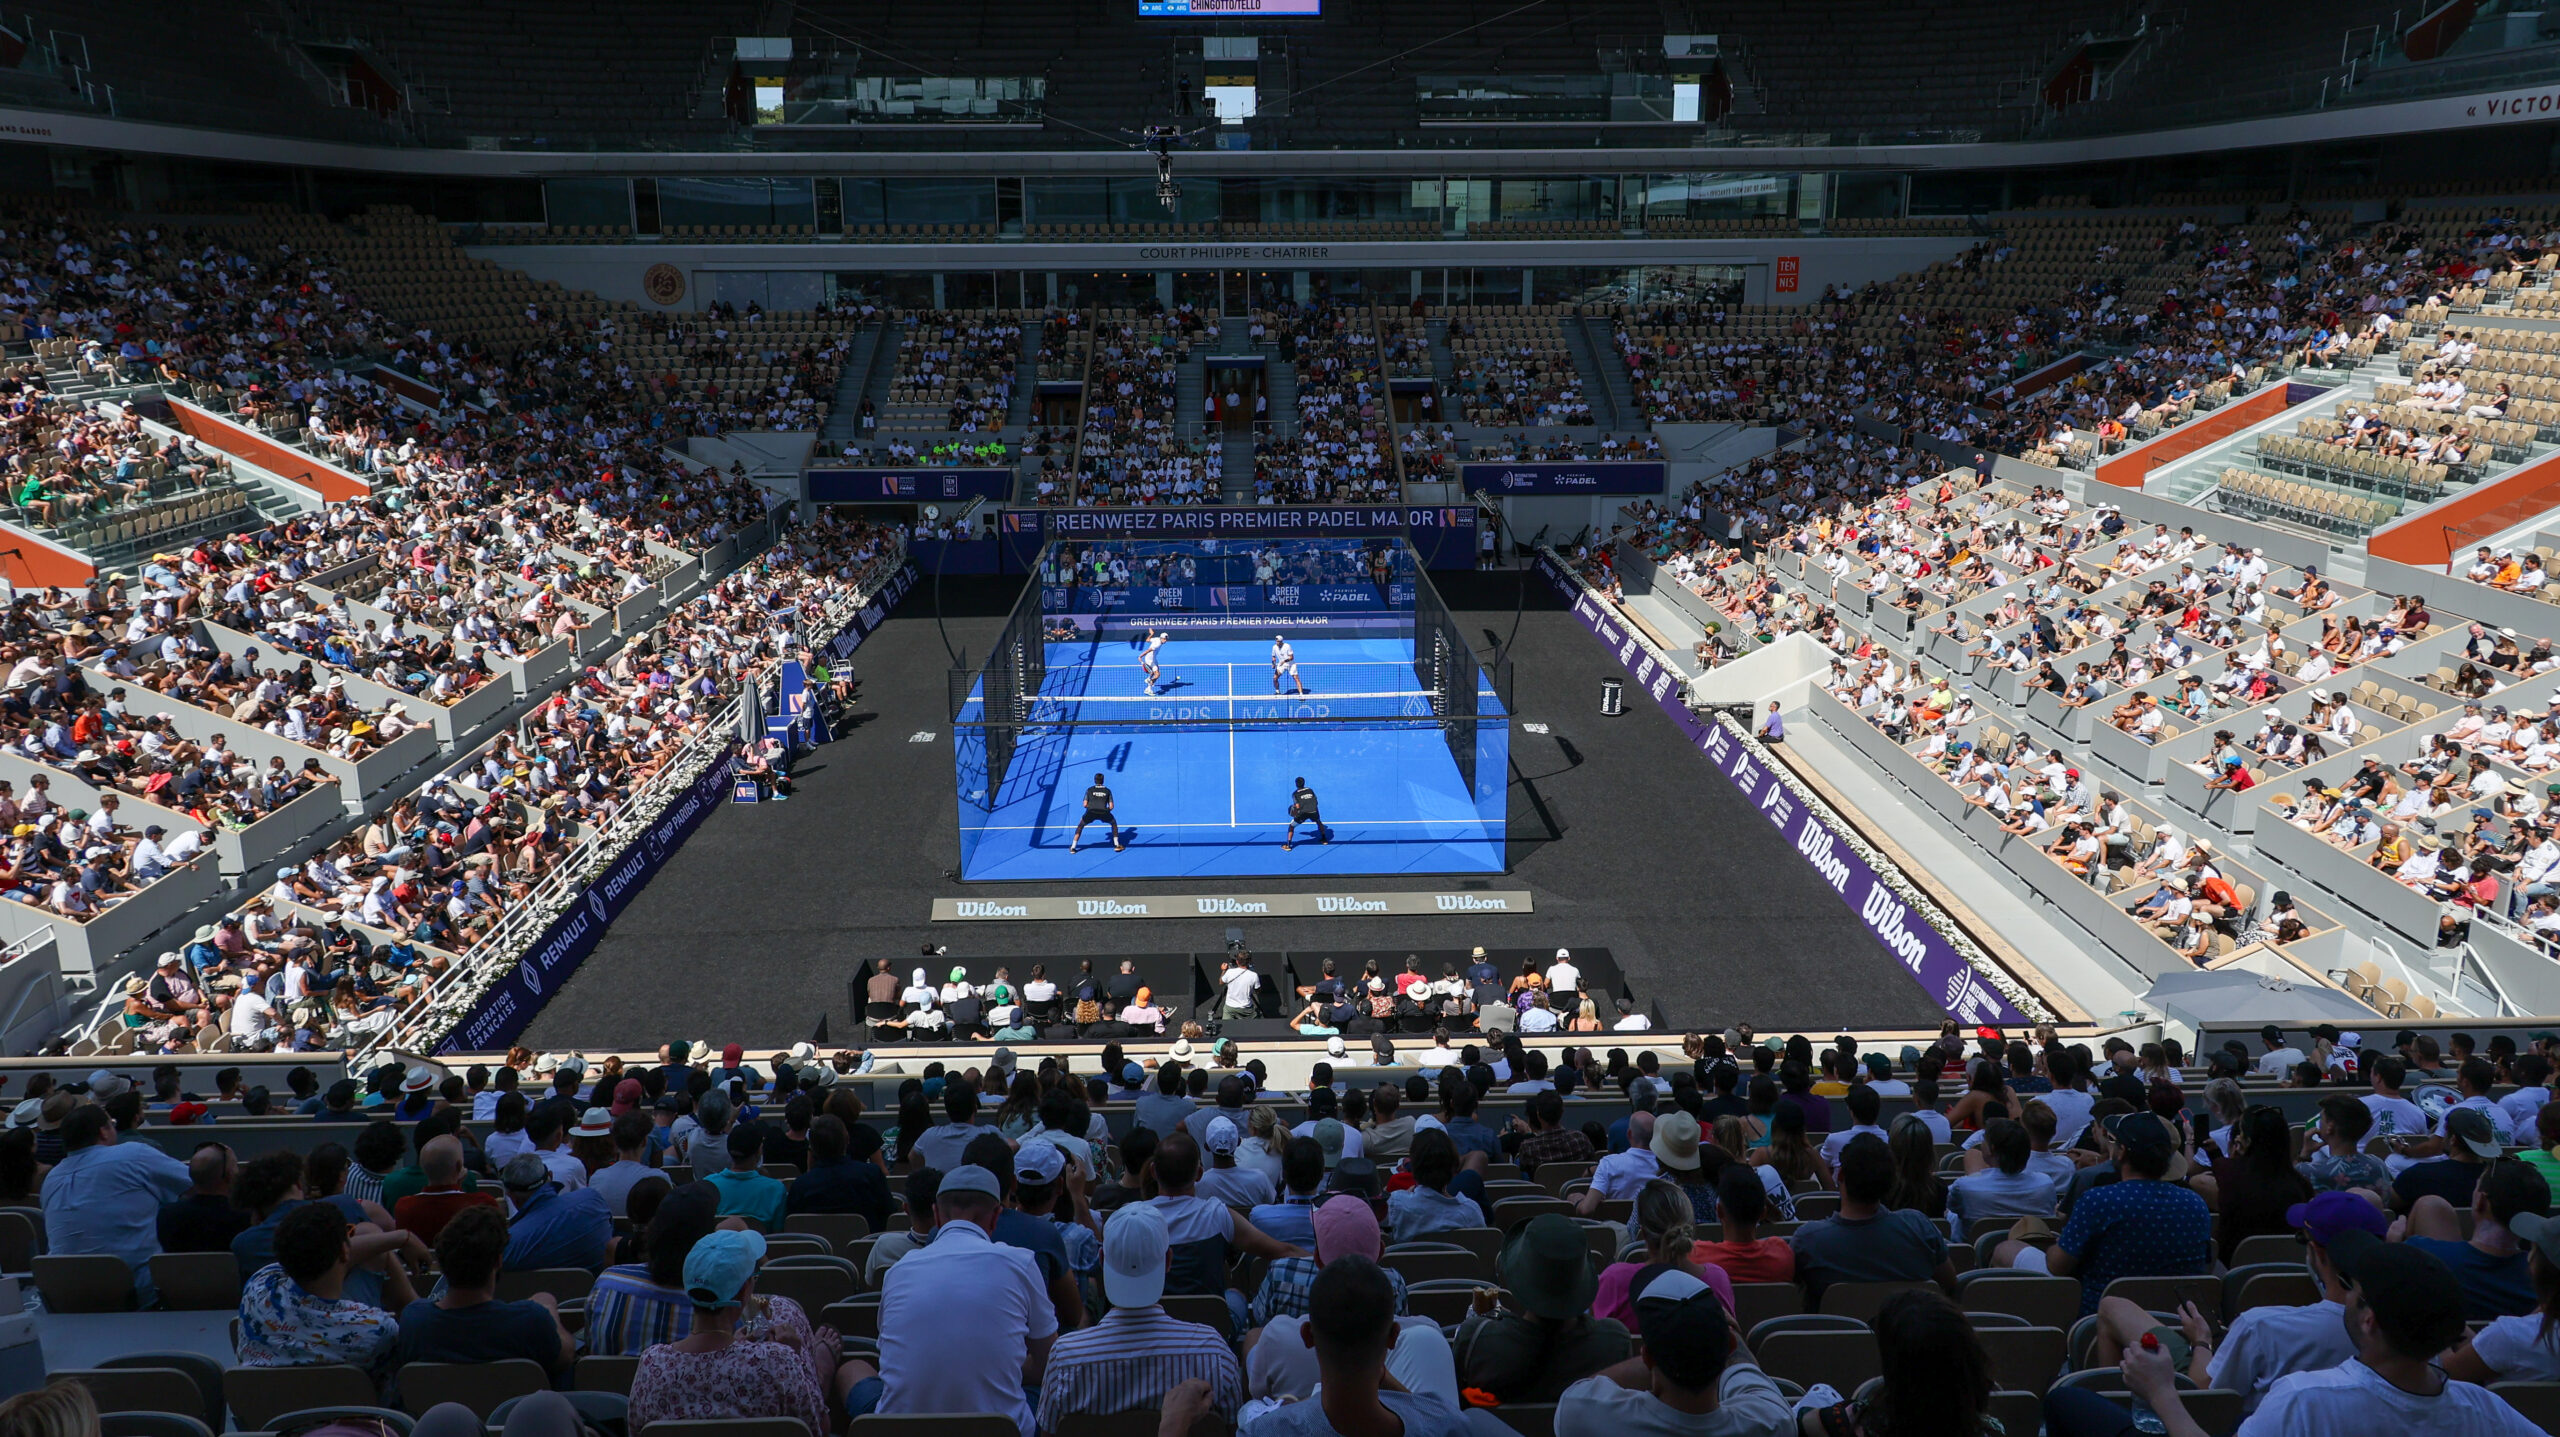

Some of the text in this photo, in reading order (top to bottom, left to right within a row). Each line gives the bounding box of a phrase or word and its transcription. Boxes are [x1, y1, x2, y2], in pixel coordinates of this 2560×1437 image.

[1190, 0, 1261, 10] CHINGOTTO/TELLO
[1140, 247, 1186, 259] COURT
[1191, 247, 1250, 258] PHILIPPE
[1262, 247, 1329, 258] CHATRIER
[1780, 260, 1796, 272] TEN
[1779, 277, 1795, 288] NIS
[1565, 477, 1597, 485] PADEL
[1162, 513, 1215, 529] PARIS
[1221, 511, 1302, 528] PREMIER
[1307, 511, 1366, 527] PADEL
[1158, 588, 1183, 597] GREEN
[1275, 587, 1300, 596] GREEN
[1332, 593, 1371, 601] PADEL
[1162, 597, 1183, 607] WEEZ
[1279, 596, 1300, 606] WEEZ
[1130, 616, 1328, 626] GREENWEEZ PARIS PREMIER PADEL MAJOR
[1601, 622, 1620, 645] RENAULT
[1602, 687, 1610, 712] Wilson
[1150, 704, 1330, 727] PARIS MAJOR
[709, 771, 722, 791] BNP
[657, 794, 701, 844] BNP PARIBAS
[1797, 815, 1850, 894] Wilson
[604, 851, 646, 901] RENAULT
[957, 901, 1028, 917] Wilson
[1077, 900, 1148, 915] Wilson
[1197, 898, 1268, 913] Wilson
[1316, 896, 1388, 912] Wilson
[1435, 894, 1507, 910] Wilson
[1862, 880, 1927, 974] Wilson
[540, 911, 589, 971] RENAULT
[1963, 991, 1979, 1013] PADEL
[1968, 980, 2003, 1020] INTERNATIONAL
[471, 1000, 517, 1051] FRANÇAISE
[2380, 1111, 2394, 1123] WE
